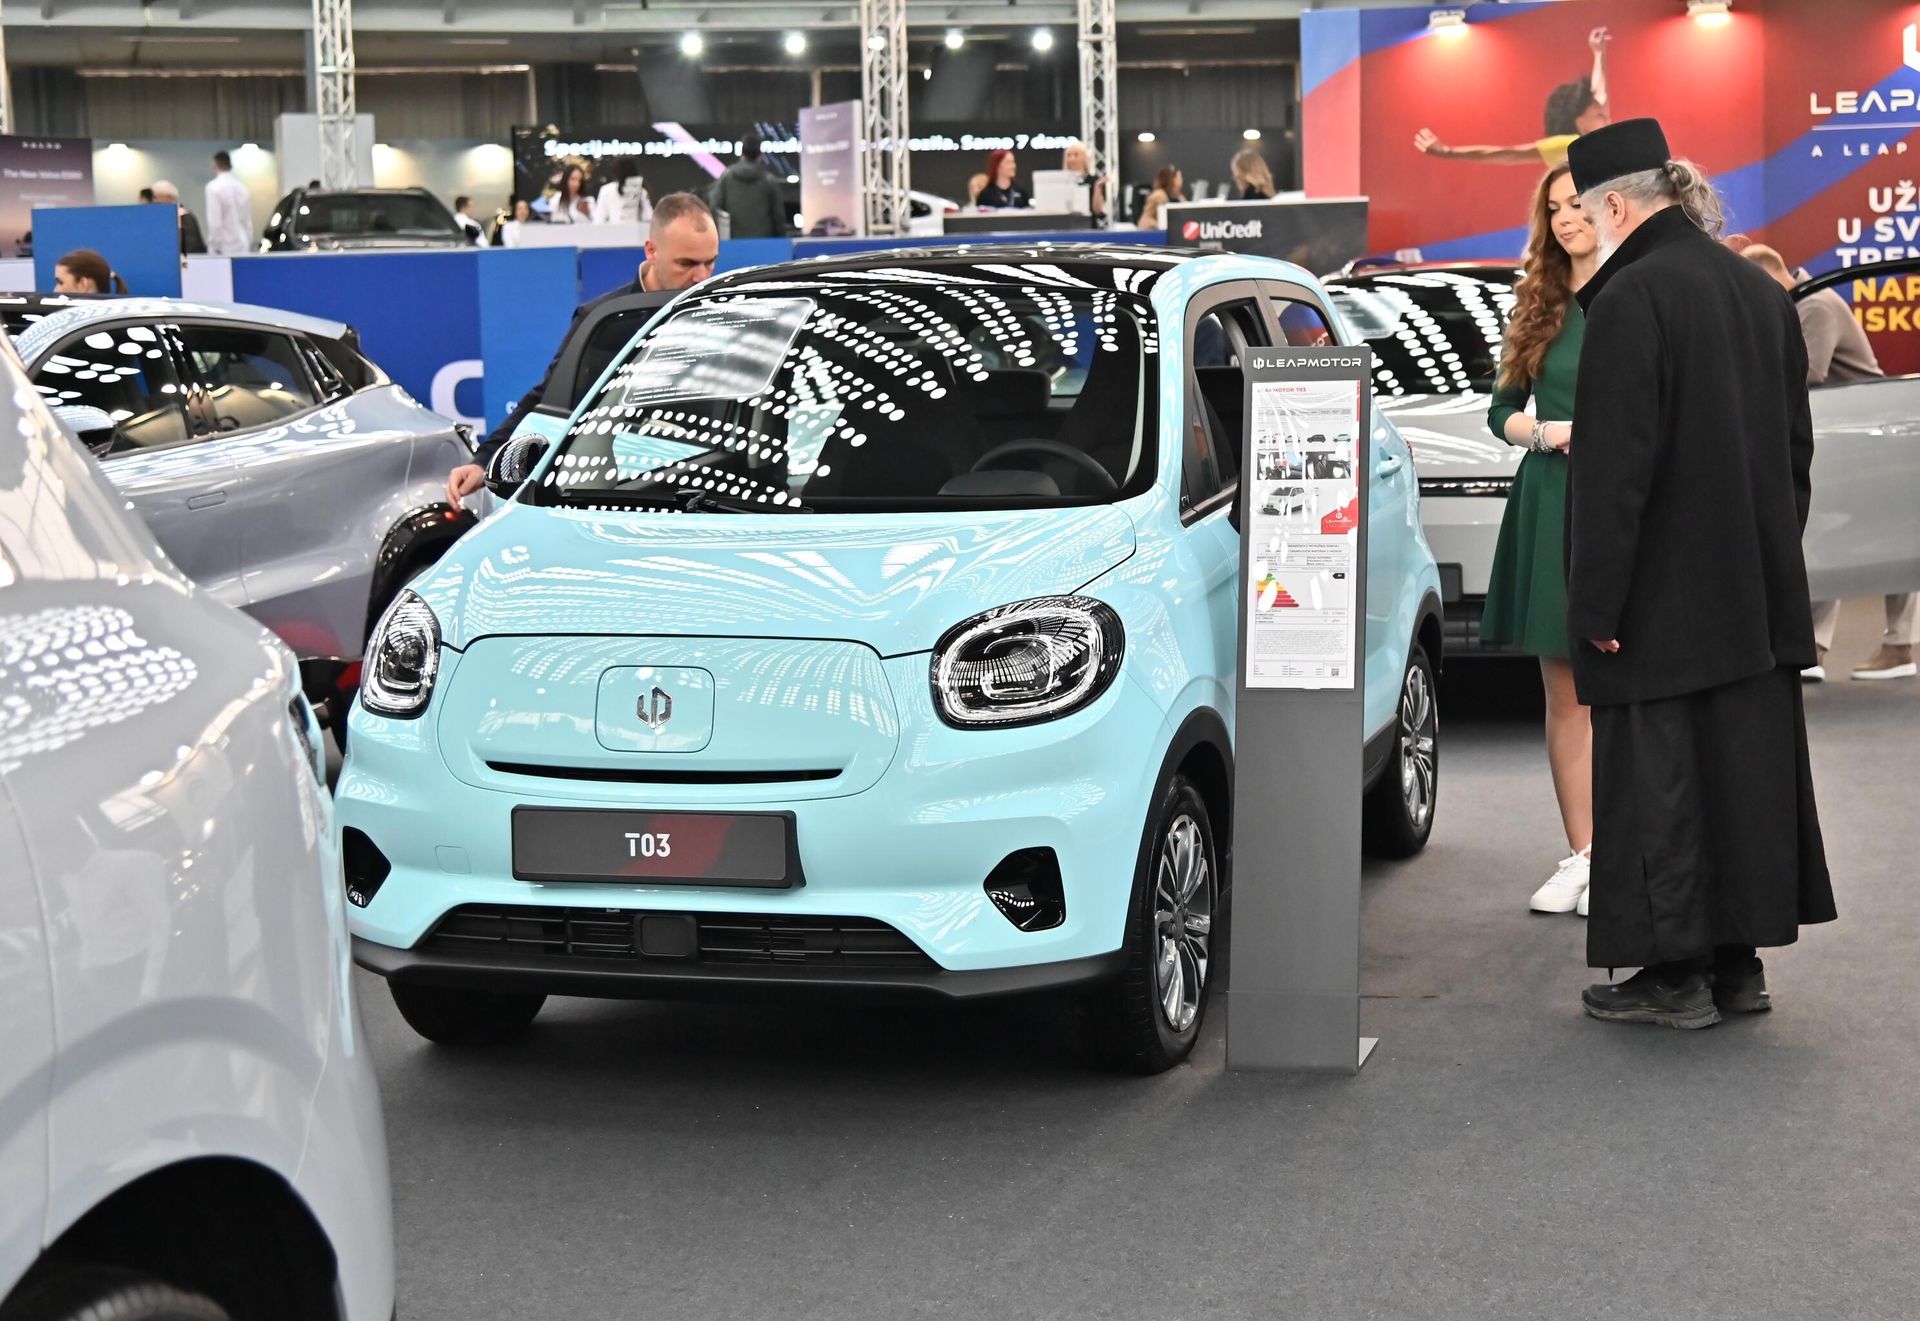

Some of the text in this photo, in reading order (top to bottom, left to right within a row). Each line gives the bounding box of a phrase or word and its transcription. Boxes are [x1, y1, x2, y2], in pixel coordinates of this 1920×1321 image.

[1810, 89, 1920, 115] LEAP
[1015, 134, 1030, 150] 7
[1811, 142, 1908, 157] A LEAP
[1868, 179, 1920, 214] UŽ
[1200, 220, 1263, 239] UniCredit
[1837, 217, 1861, 243] U
[1266, 357, 1362, 368] LEAPMOTOR
[624, 832, 671, 858] T03
